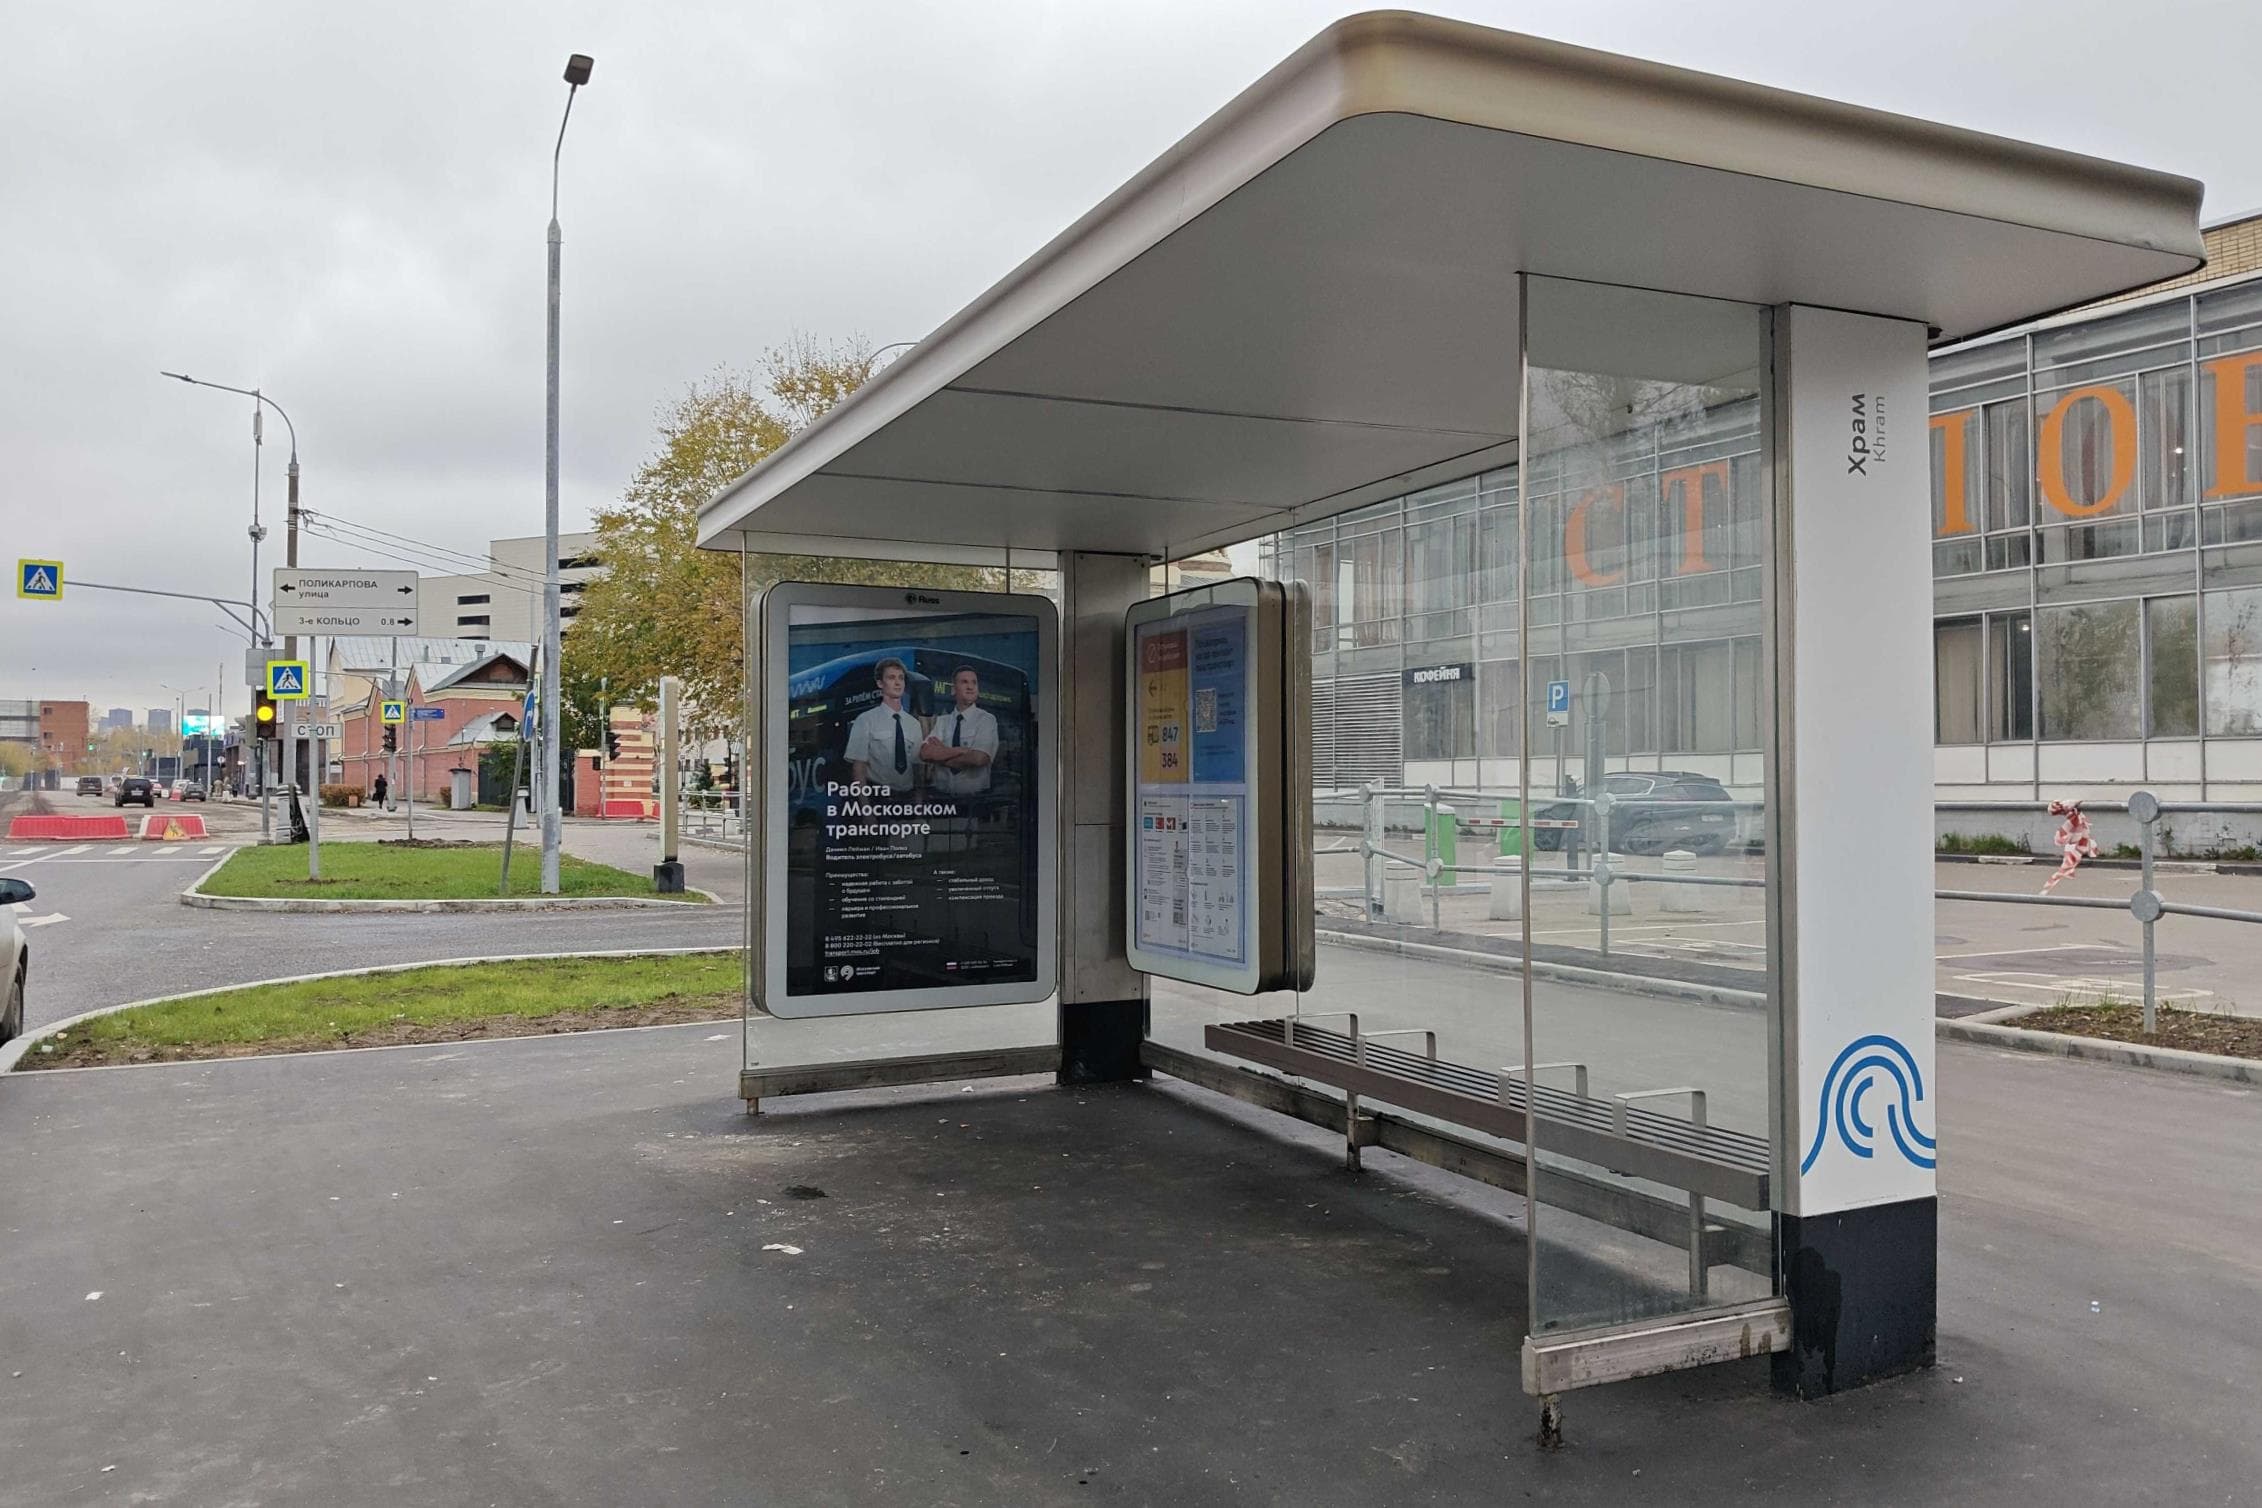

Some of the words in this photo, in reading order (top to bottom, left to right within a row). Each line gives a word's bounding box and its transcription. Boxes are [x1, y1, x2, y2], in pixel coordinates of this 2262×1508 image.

[1848, 393, 1870, 476] Храм
[1873, 396, 1885, 462] Khram
[298, 579, 378, 589] ПОЛИКАРПОВА
[298, 590, 329, 599] улица
[298, 617, 314, 625] 3-е
[316, 617, 360, 626] КОЛЬЦО
[1413, 666, 1460, 683] КОФЕЙНЯ
[1552, 685, 1564, 709] P
[297, 725, 335, 736] СОП
[1161, 726, 1179, 743] 847
[1161, 753, 1178, 768] 384
[826, 781, 891, 797] Работа
[826, 805, 837, 817] в
[842, 801, 957, 817] Московском
[826, 823, 931, 840] транспорте
